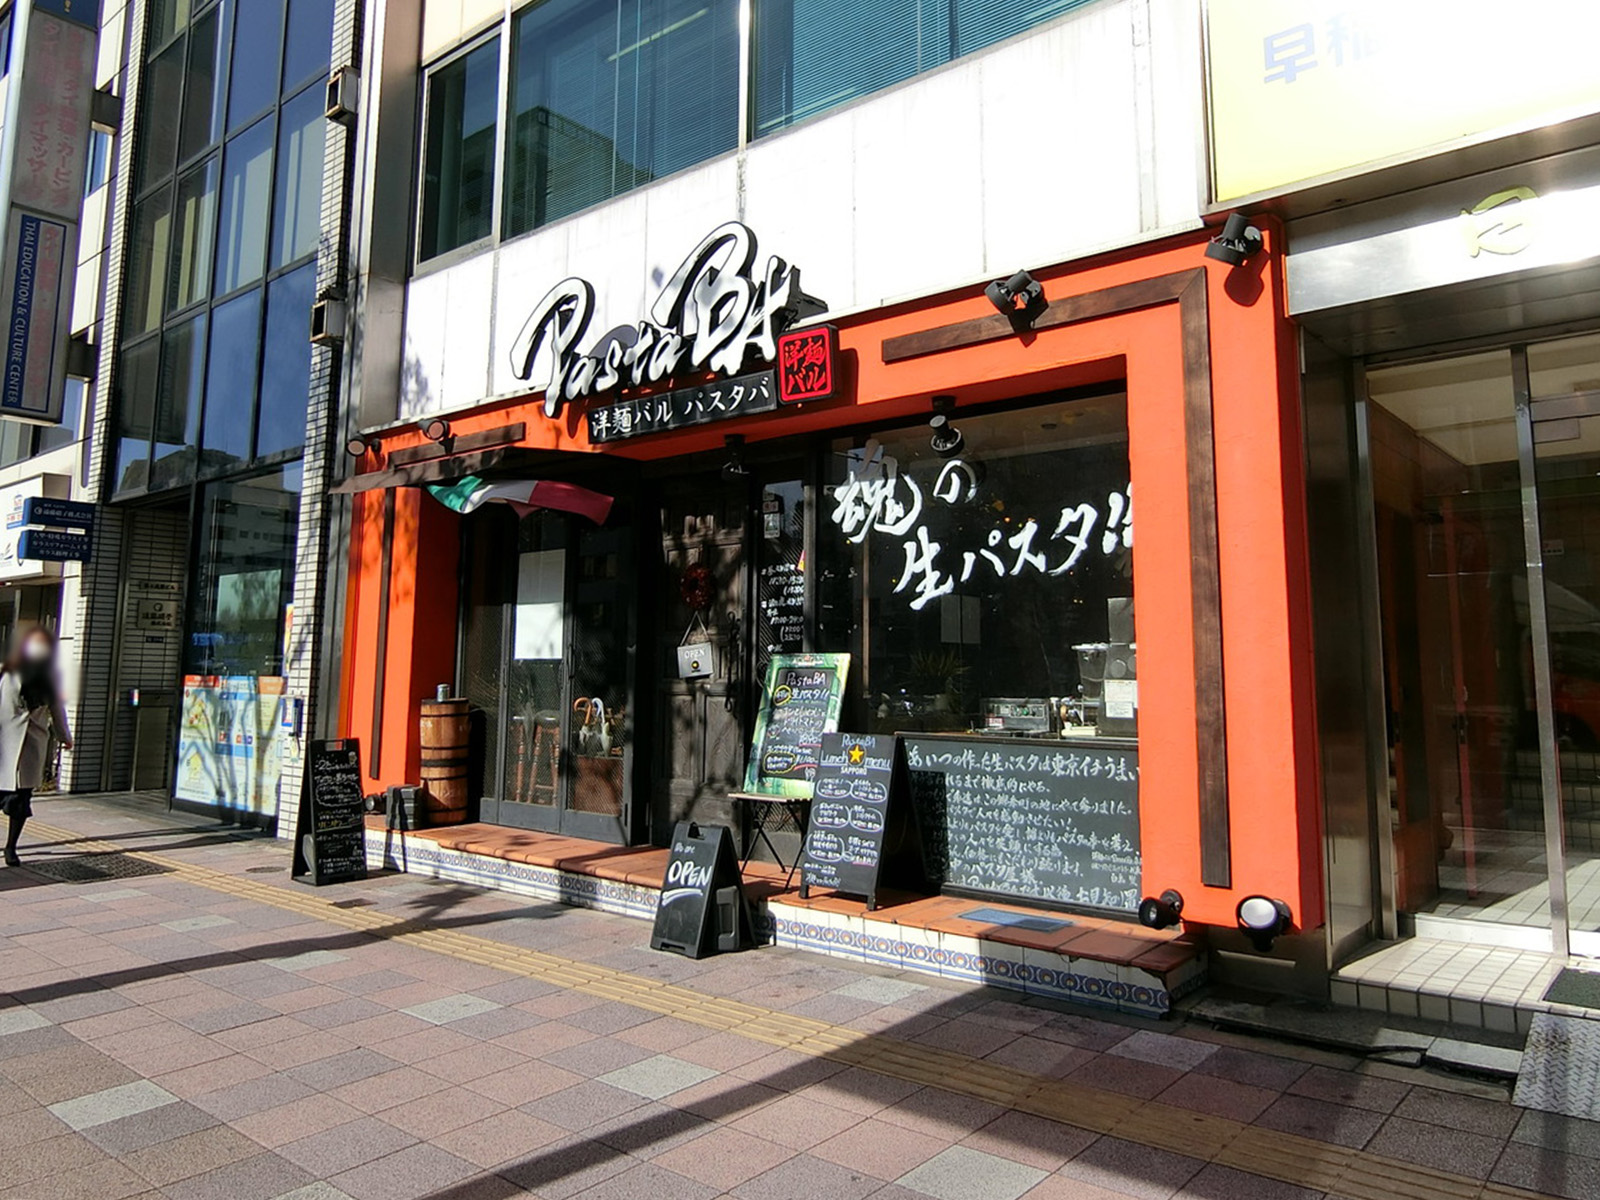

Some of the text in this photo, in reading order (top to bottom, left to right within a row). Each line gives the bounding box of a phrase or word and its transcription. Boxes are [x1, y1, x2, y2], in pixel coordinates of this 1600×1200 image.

[8, 222, 36, 402] THAI EDUCATION & CULTURE CENTER
[786, 367, 825, 393] バル
[592, 376, 769, 440] 洋麺バル パスタバ
[820, 750, 848, 764] Lunch
[864, 756, 891, 769] menu
[840, 766, 867, 775] SAPPORO
[668, 860, 711, 887] OPEN
